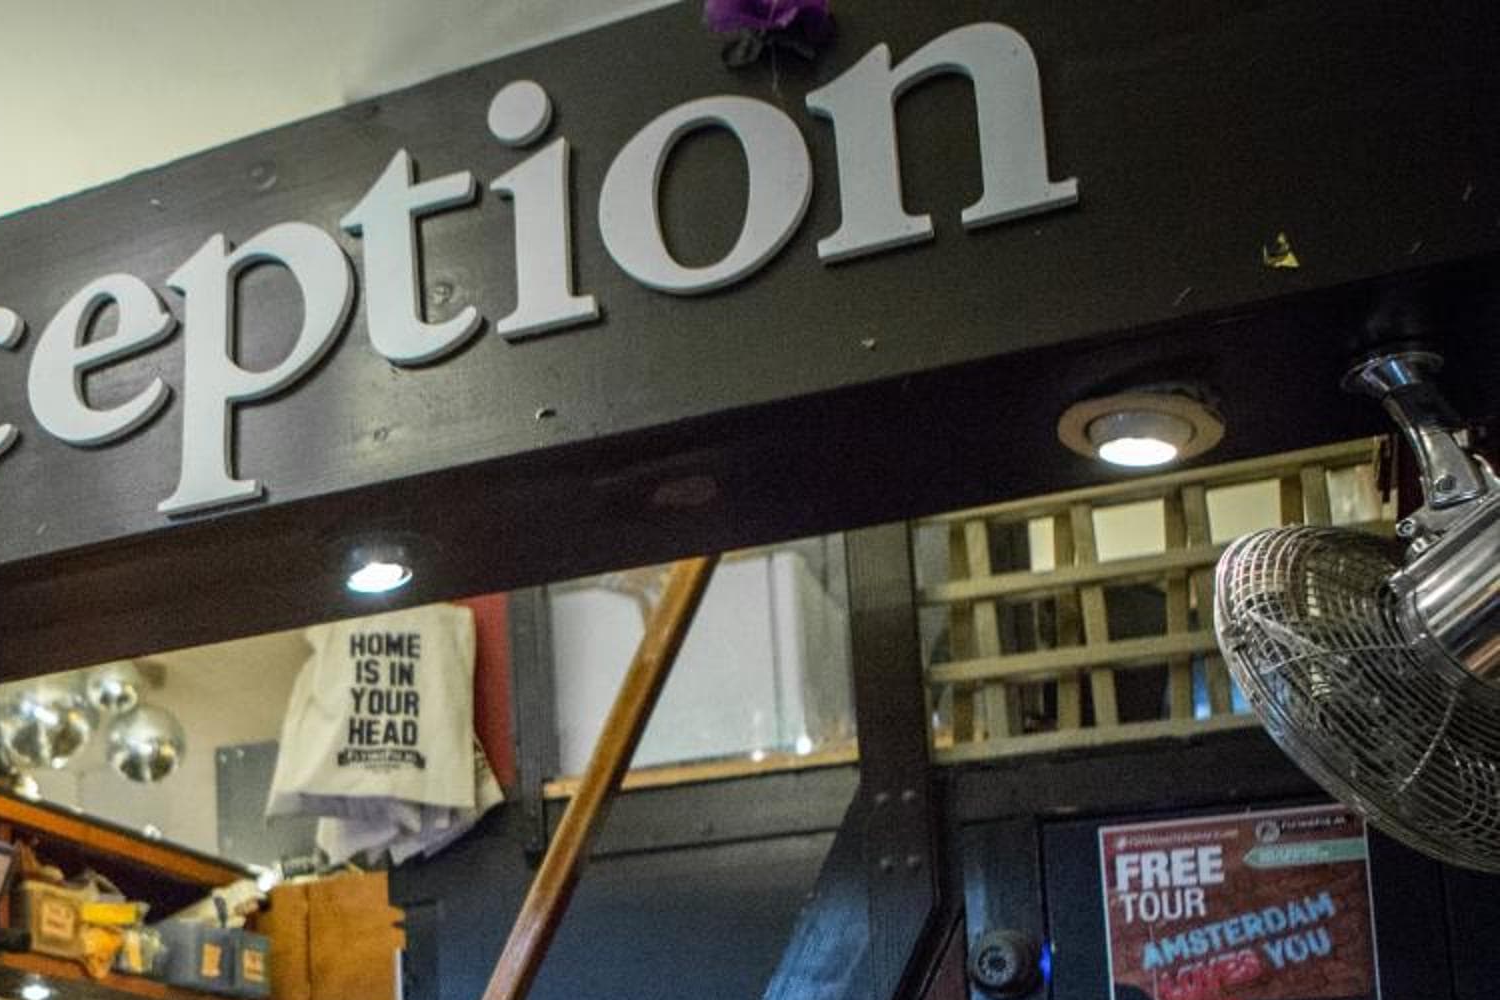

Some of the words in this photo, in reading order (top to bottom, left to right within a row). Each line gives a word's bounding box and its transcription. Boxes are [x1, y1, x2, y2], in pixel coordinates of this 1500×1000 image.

[349, 632, 421, 658] HOME
[355, 660, 380, 685] IS
[389, 661, 414, 686] IN
[350, 687, 420, 717] YOUR
[348, 716, 418, 745] HEAD
[1115, 845, 1225, 891] FREE
[1118, 887, 1207, 923] TOUR
[1141, 890, 1336, 970] AMSTERDAM
[1263, 926, 1333, 970] YOU
